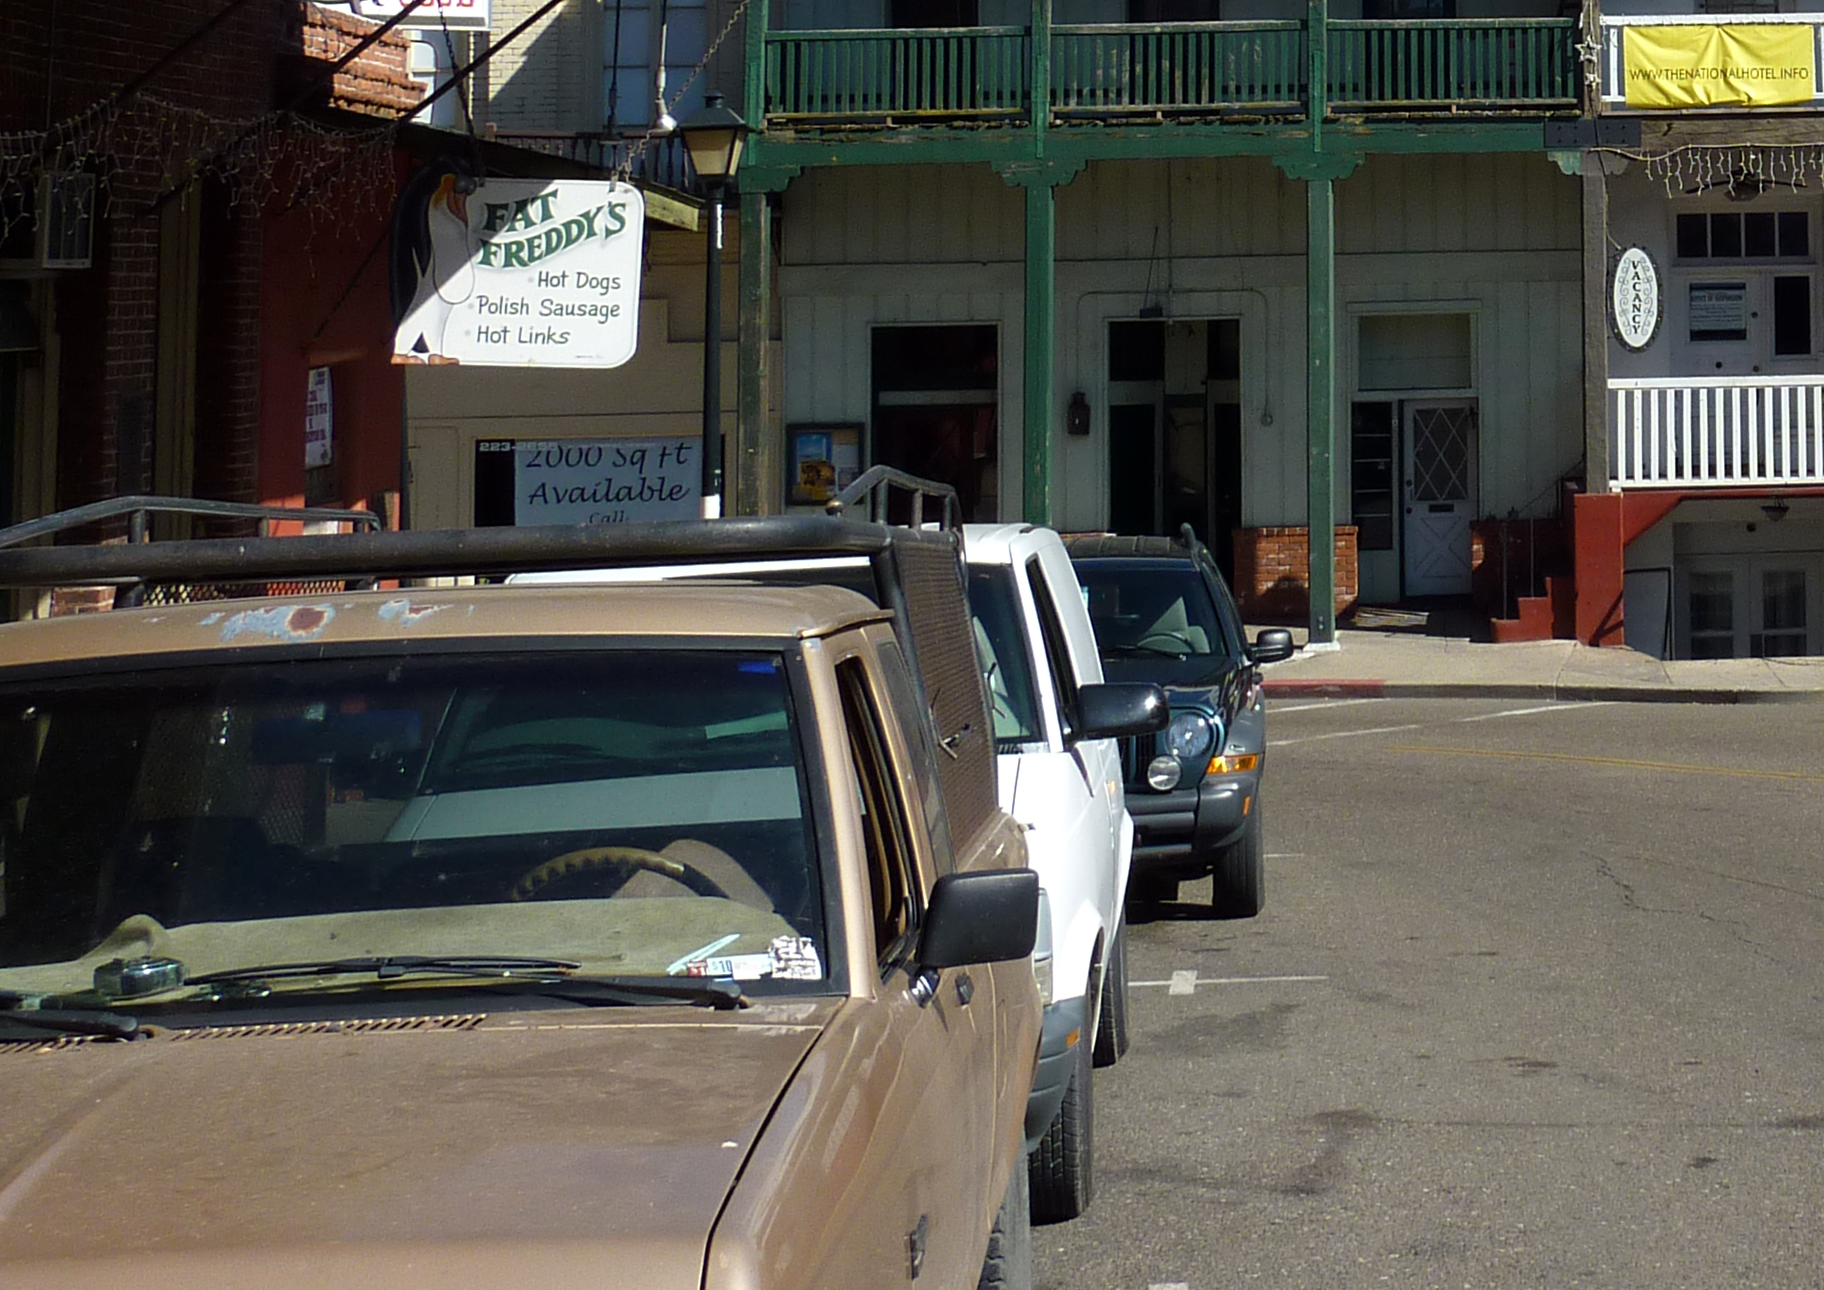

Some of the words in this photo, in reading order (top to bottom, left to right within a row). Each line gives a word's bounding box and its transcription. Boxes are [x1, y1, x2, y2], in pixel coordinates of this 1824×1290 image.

[483, 188, 559, 233] FAT
[476, 201, 627, 269] FREDDY'S
[537, 270, 569, 289] Hot
[576, 271, 622, 296] Dogs
[1631, 260, 1642, 335] VACANCY
[476, 295, 530, 316] Polish
[538, 298, 621, 324] Sausage
[476, 325, 511, 345] Hot
[518, 325, 571, 345] Links
[528, 476, 692, 505] Available
